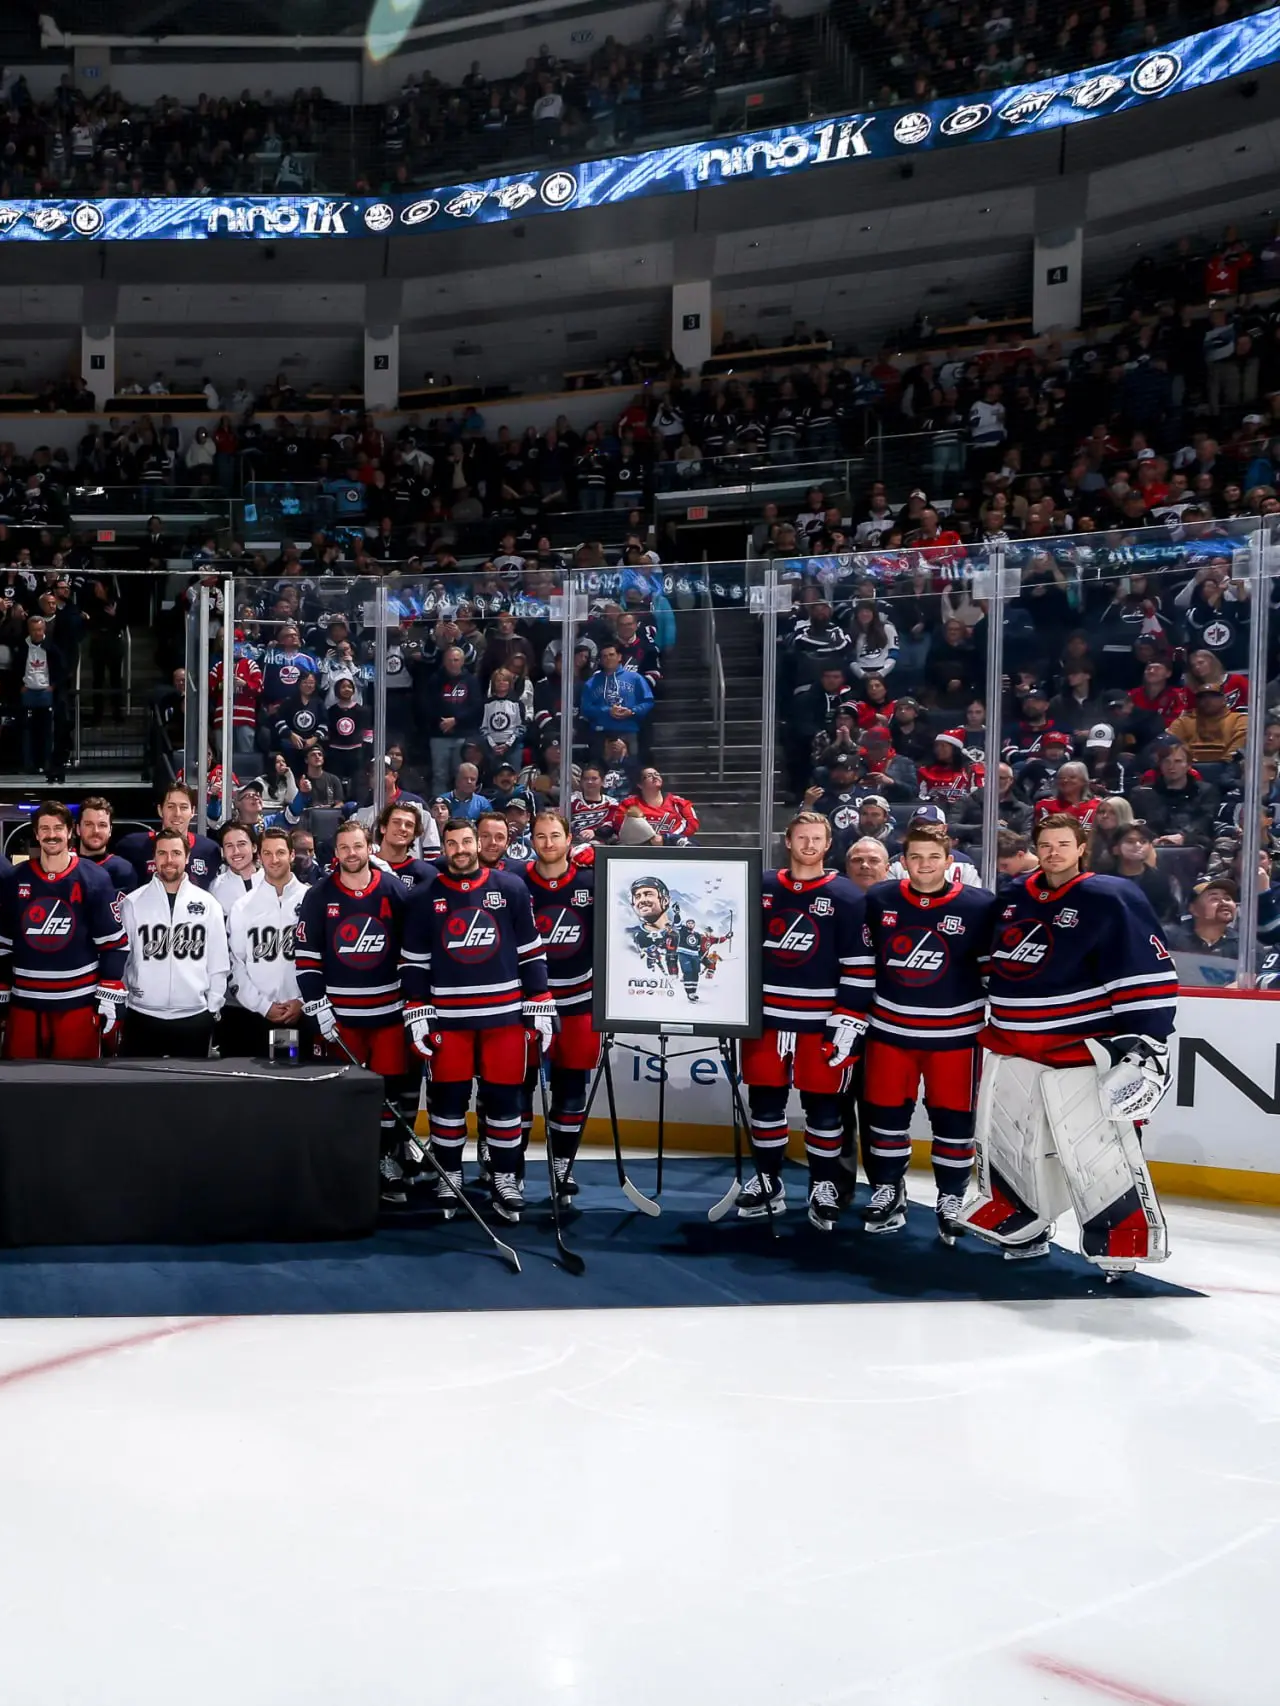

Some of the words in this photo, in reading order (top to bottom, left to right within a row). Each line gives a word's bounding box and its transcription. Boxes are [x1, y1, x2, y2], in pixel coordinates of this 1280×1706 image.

[810, 117, 875, 165] 1K
[301, 202, 350, 235] 1K
[1052, 267, 1061, 281] 4
[688, 315, 696, 329] 3
[377, 355, 385, 368] 2
[70, 882, 82, 904] A
[380, 896, 392, 919] A
[26, 900, 72, 935] JETS
[296, 921, 307, 943] 4
[338, 917, 385, 954] JETS
[447, 909, 496, 949] JETS
[542, 907, 582, 944] JETS
[763, 913, 816, 951] JETS
[138, 923, 206, 961] 1000
[247, 925, 296, 963] 100
[887, 930, 945, 971] JETS
[992, 923, 1048, 964] JETS
[1149, 934, 1169, 960] 1
[628, 978, 658, 989] nino
[1134, 1166, 1158, 1225] TRUE
